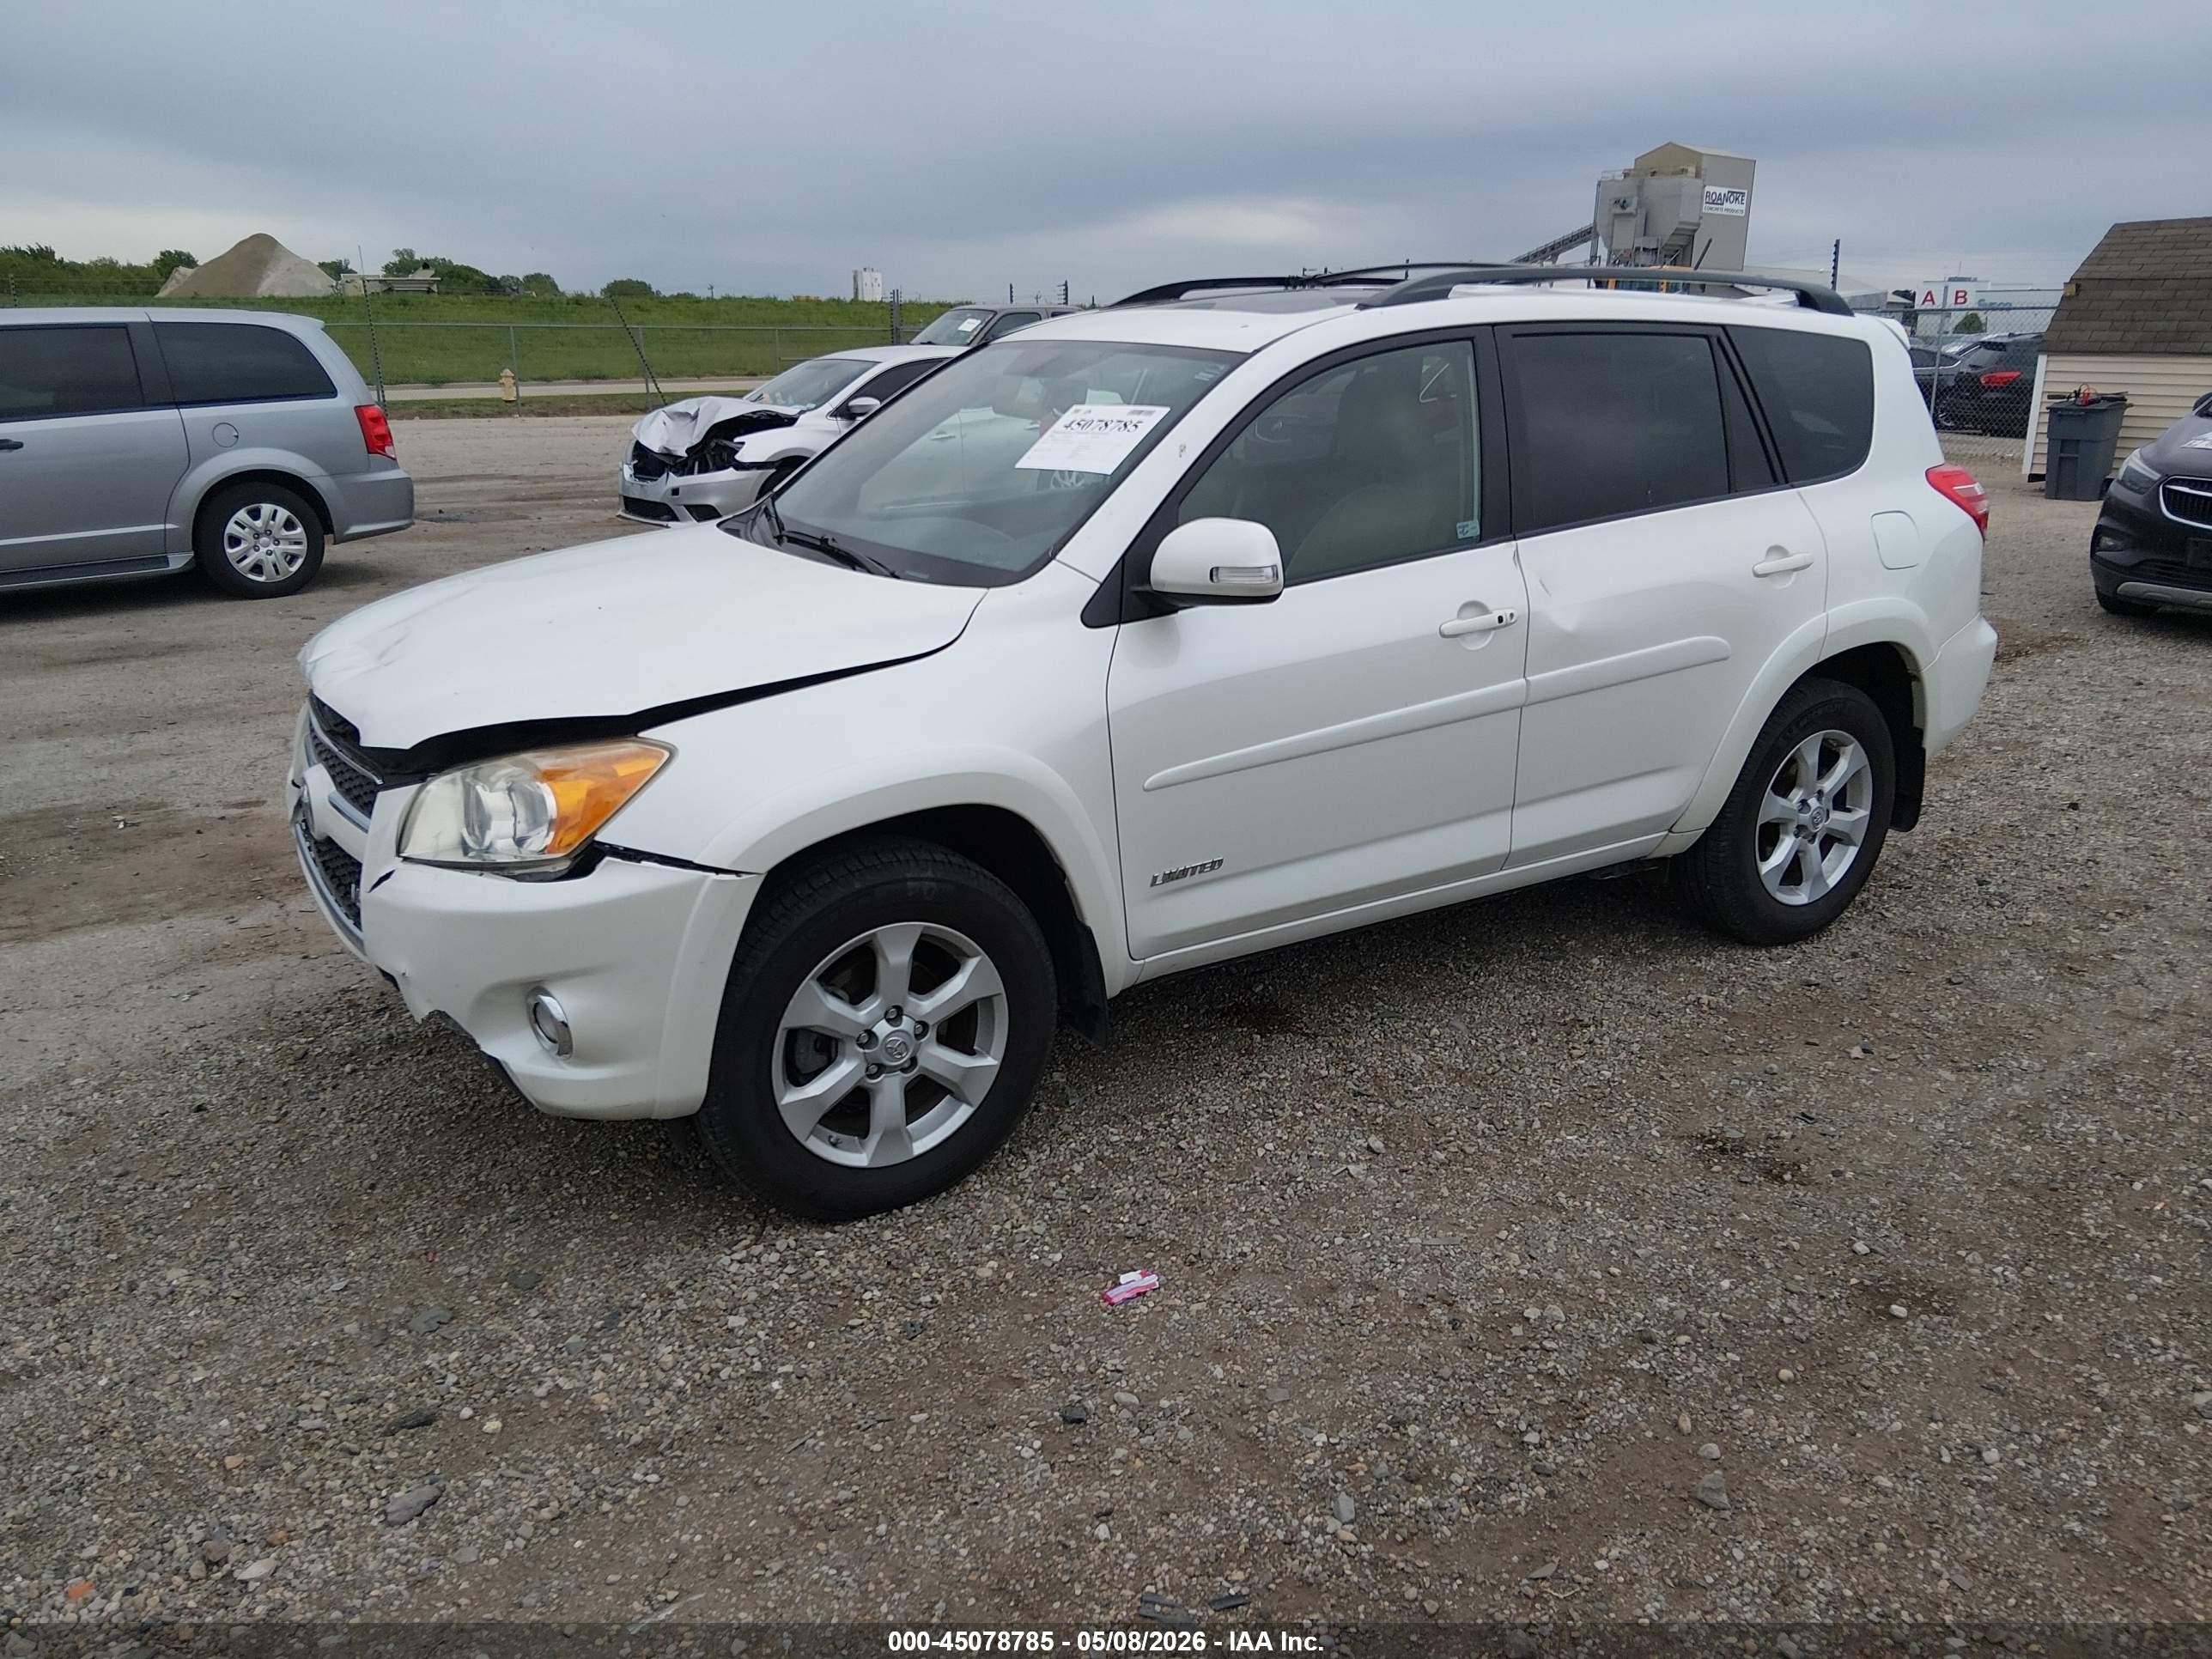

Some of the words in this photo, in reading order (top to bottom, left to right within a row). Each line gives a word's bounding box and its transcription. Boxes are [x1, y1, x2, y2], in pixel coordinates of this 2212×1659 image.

[1705, 191, 1746, 205] ROANOKE
[1921, 290, 1936, 306] A
[1954, 290, 1967, 305] B
[1063, 418, 1144, 433] 45078785
[1150, 857, 1224, 887] LIMITED
